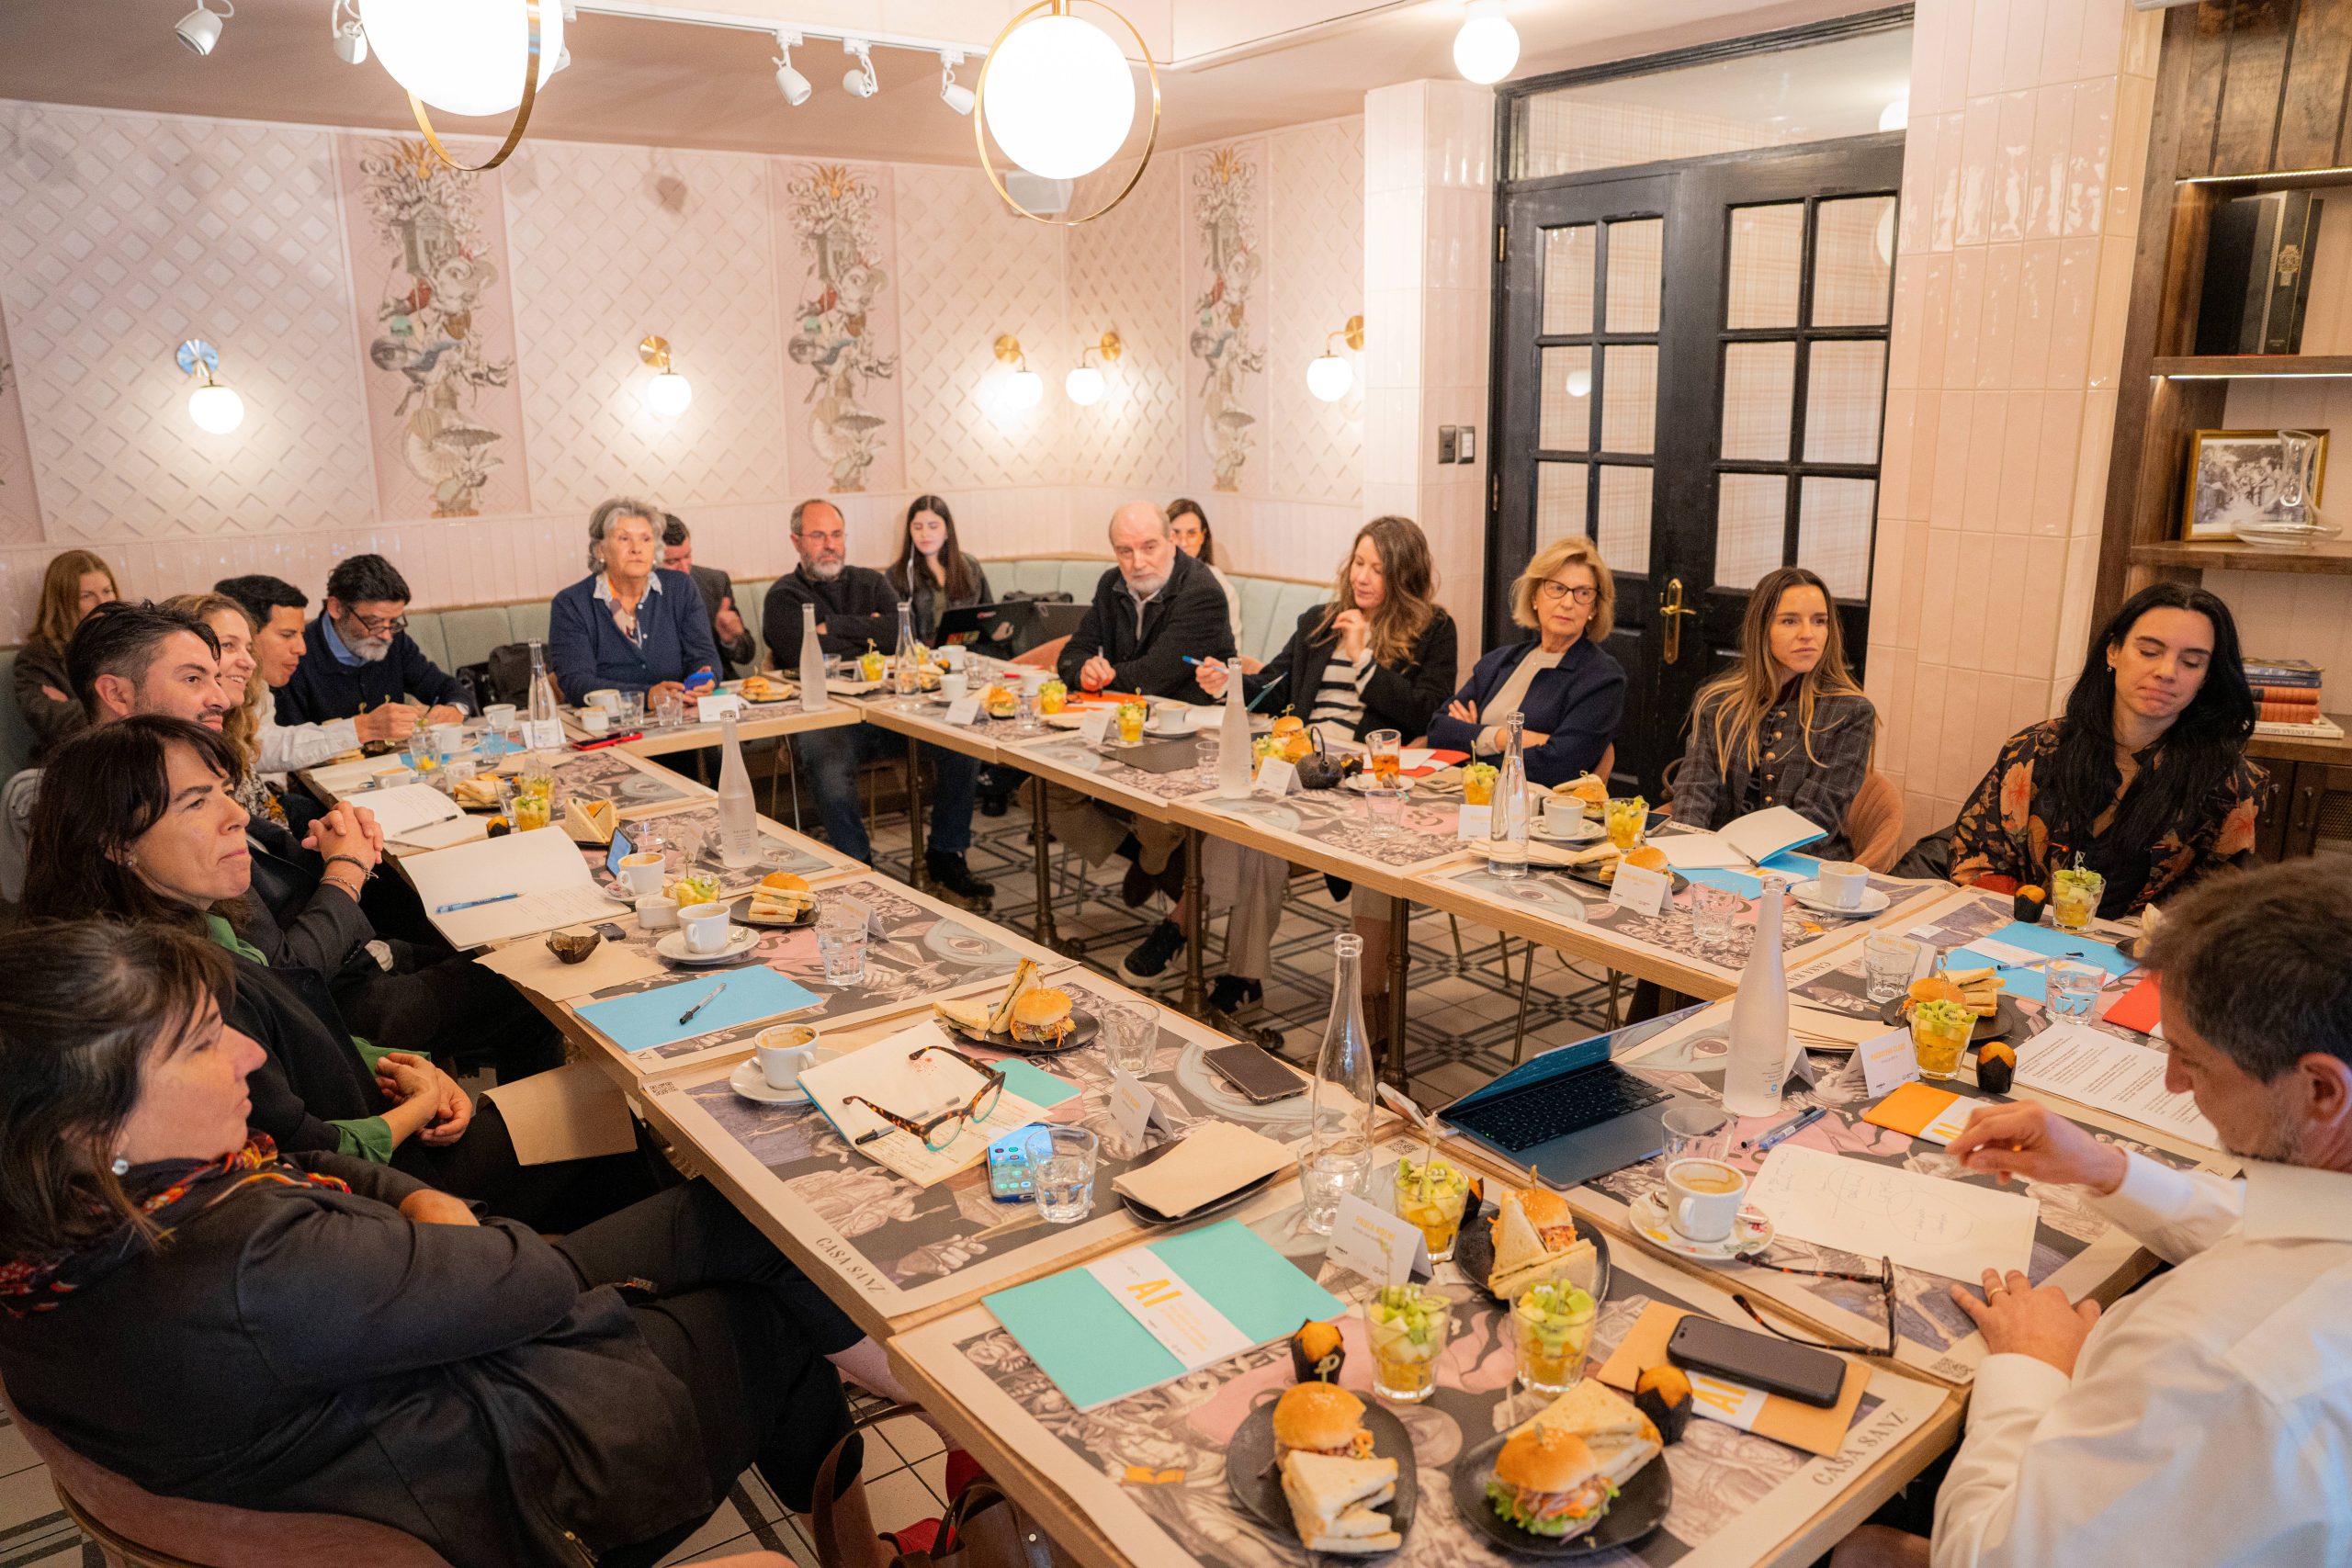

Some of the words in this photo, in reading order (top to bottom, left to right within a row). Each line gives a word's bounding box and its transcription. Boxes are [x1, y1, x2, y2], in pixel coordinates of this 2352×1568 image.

[1786, 973, 1806, 984] SA
[815, 1237, 852, 1265] CASA
[846, 1266, 886, 1294] SANZ
[1125, 1279, 1183, 1308] AI
[1812, 1450, 1867, 1485] CASA
[1857, 1412, 1908, 1448] SANZ
